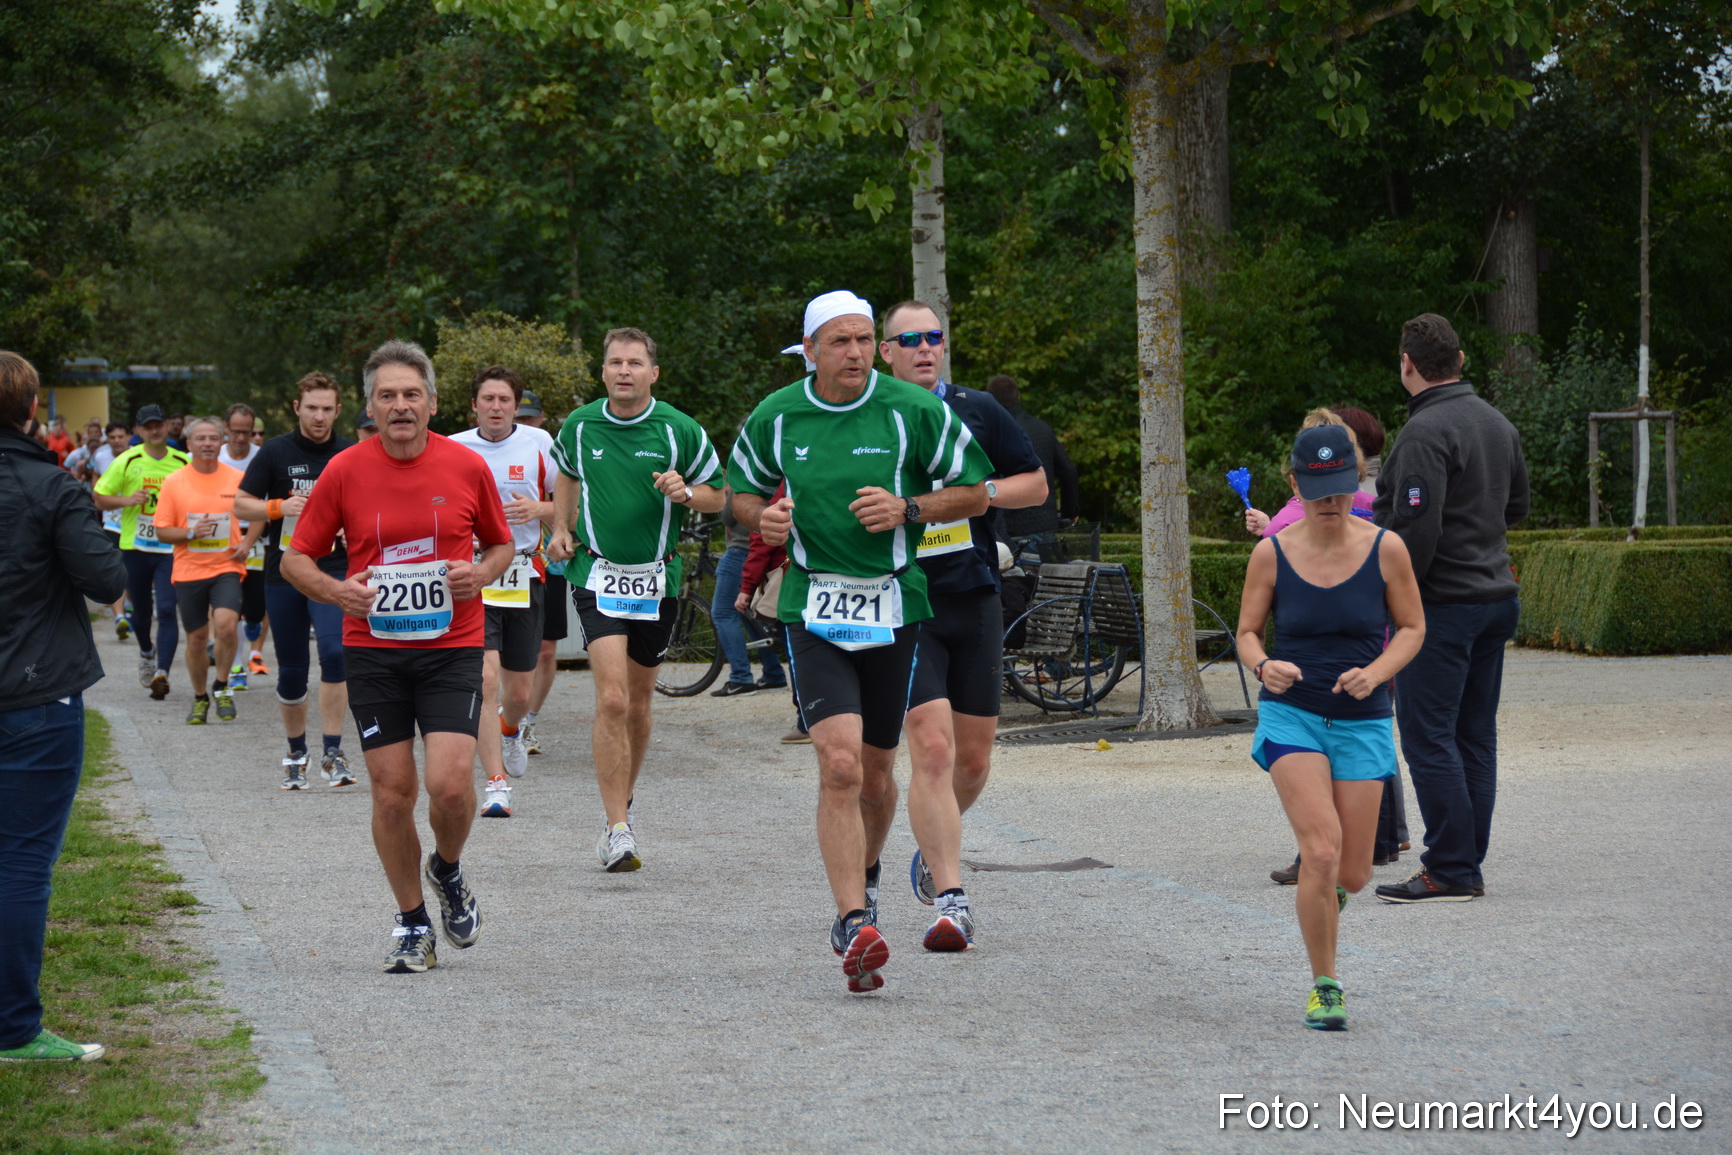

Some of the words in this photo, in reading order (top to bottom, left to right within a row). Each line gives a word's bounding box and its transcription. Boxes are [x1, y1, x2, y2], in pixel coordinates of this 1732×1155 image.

[852, 446, 880, 456] africon
[396, 544, 420, 557] DEHN
[598, 564, 620, 573] PARTL
[370, 572, 394, 581] PARTL
[395, 570, 436, 580] Neumarkt
[603, 574, 659, 597] 2664
[812, 581, 838, 589] PARTL
[840, 581, 879, 591] Neumarkt
[375, 580, 445, 613] 2206
[616, 600, 643, 611] Rainer
[816, 591, 881, 623] 2421
[384, 618, 438, 632] Wolfgang
[827, 627, 872, 640] Gerhard
